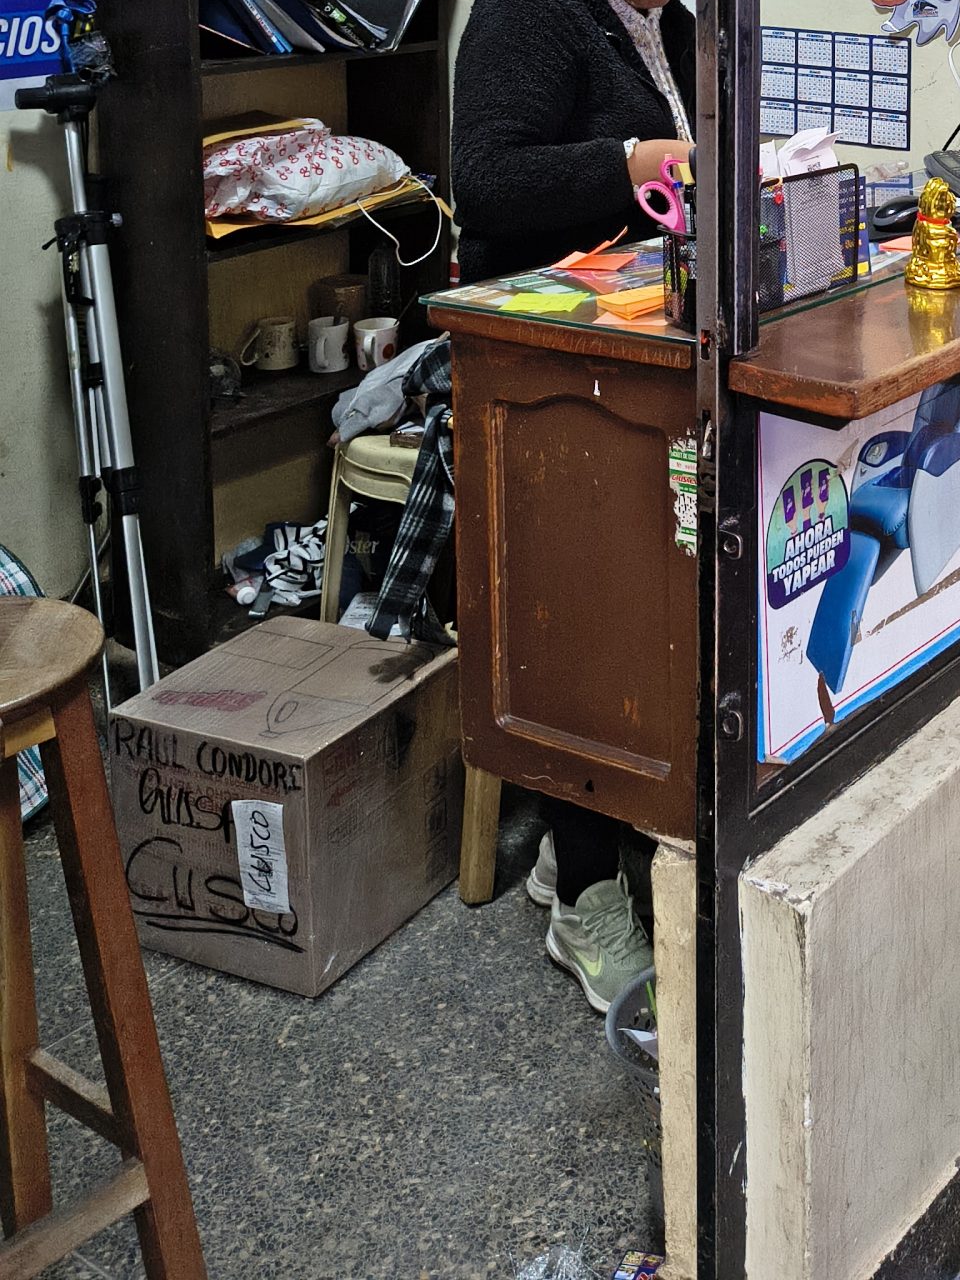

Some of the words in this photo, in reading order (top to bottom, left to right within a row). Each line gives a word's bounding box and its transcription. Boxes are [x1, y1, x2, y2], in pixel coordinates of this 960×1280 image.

[772, 551, 806, 582] TODOS
[807, 529, 844, 562] PUEDEN
[784, 516, 833, 561] AHORA
[783, 549, 836, 596] YAPEAR
